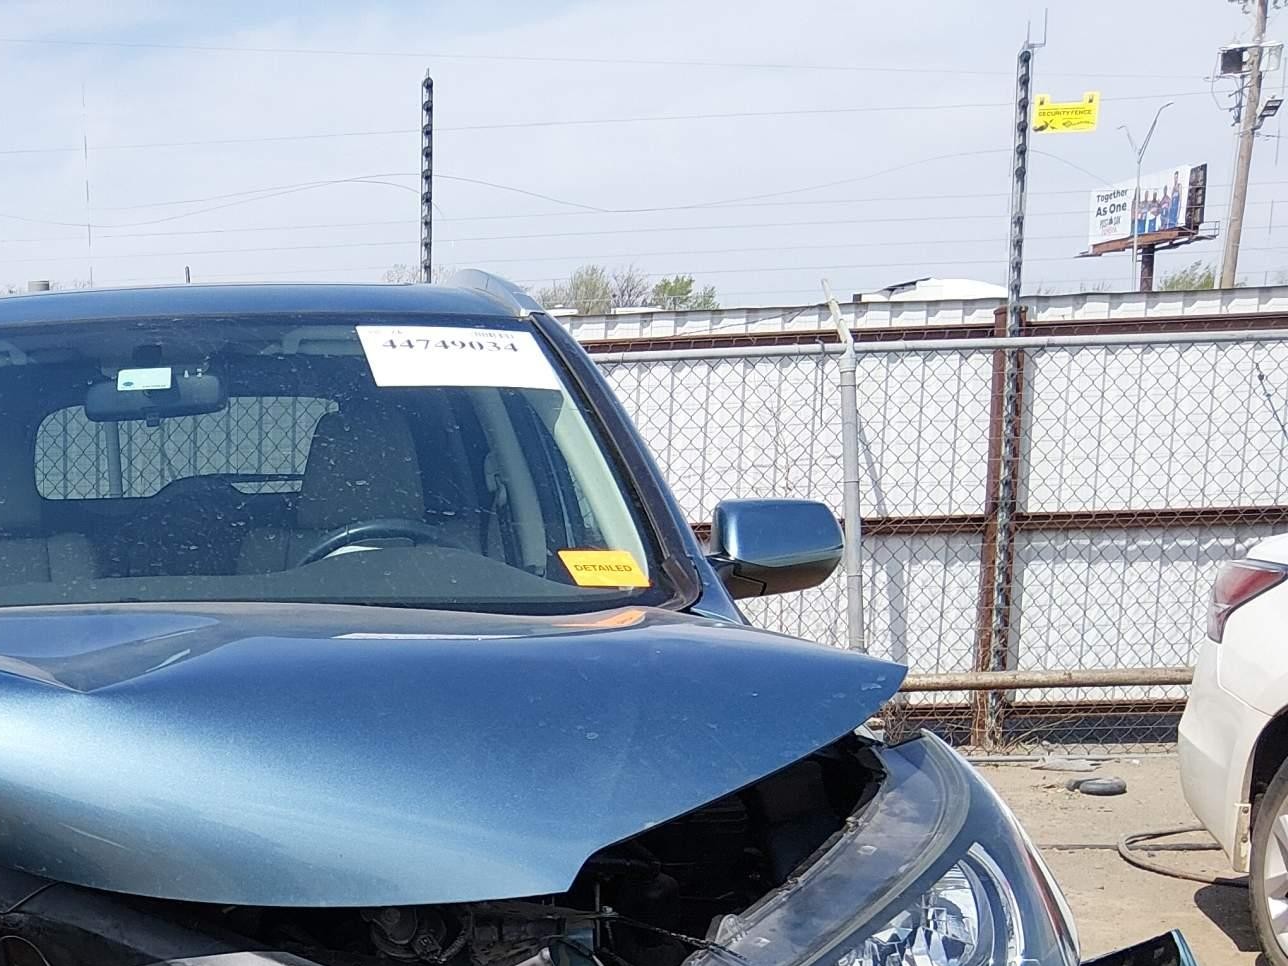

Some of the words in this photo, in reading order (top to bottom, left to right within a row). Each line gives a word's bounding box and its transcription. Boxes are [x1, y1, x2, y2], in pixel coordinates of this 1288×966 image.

[1096, 189, 1128, 203] Together
[1096, 206, 1108, 217] As
[1108, 202, 1127, 214] One
[382, 338, 519, 353] 44749034
[573, 564, 633, 572] DETAILED
